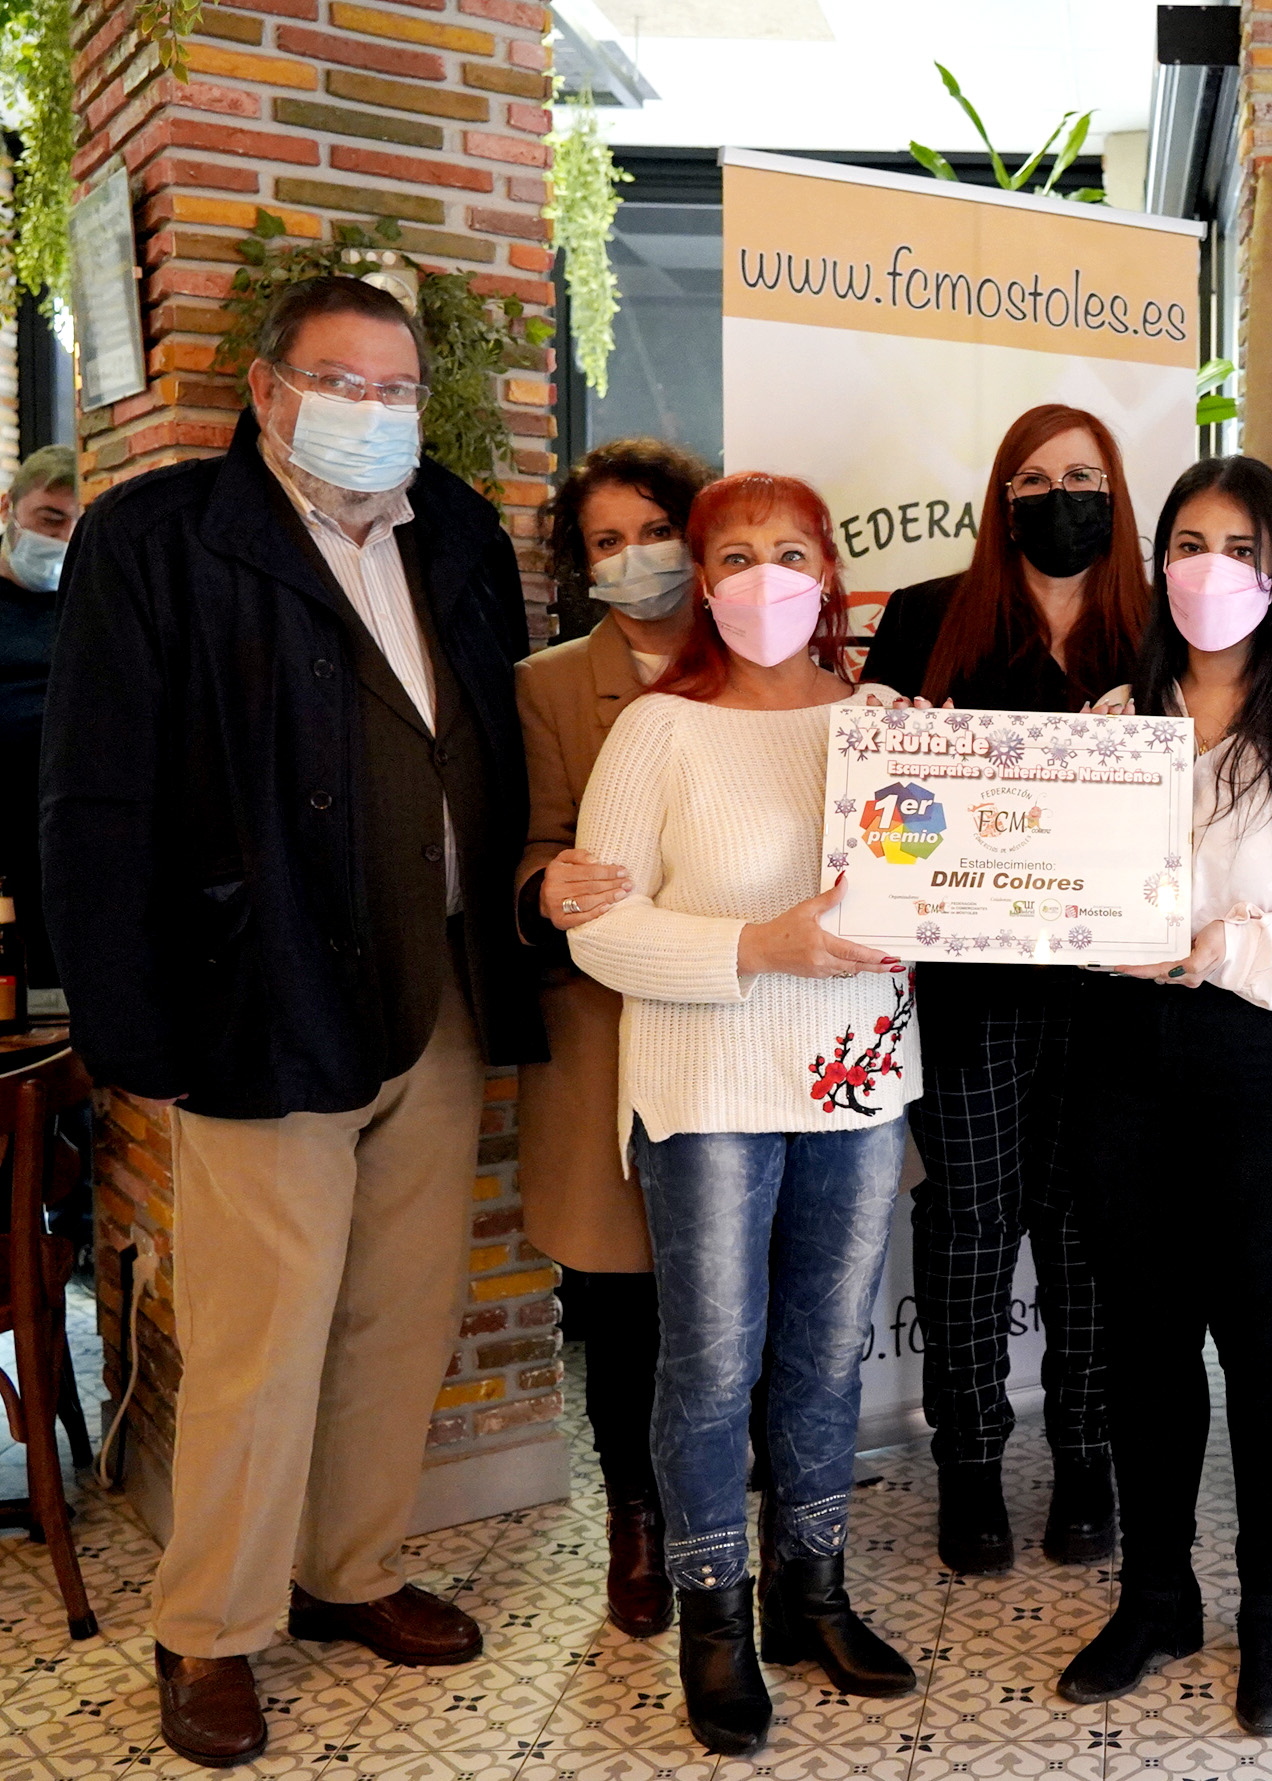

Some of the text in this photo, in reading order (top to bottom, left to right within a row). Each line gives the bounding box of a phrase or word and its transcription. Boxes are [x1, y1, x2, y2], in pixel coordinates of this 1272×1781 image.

[740, 246, 1187, 342] www.fcmostoles.es
[857, 728, 991, 756] X Ruta de
[887, 760, 1163, 785] Escaparates e Interiores Navideños
[980, 787, 1033, 799] FEDERACIÓN
[874, 795, 933, 829] 1er
[978, 810, 1025, 832] FCM
[867, 830, 939, 844] premio
[960, 857, 1056, 871] Establecimiento:
[930, 870, 1084, 891] DMil Colores
[1079, 908, 1123, 917] Móstoles
